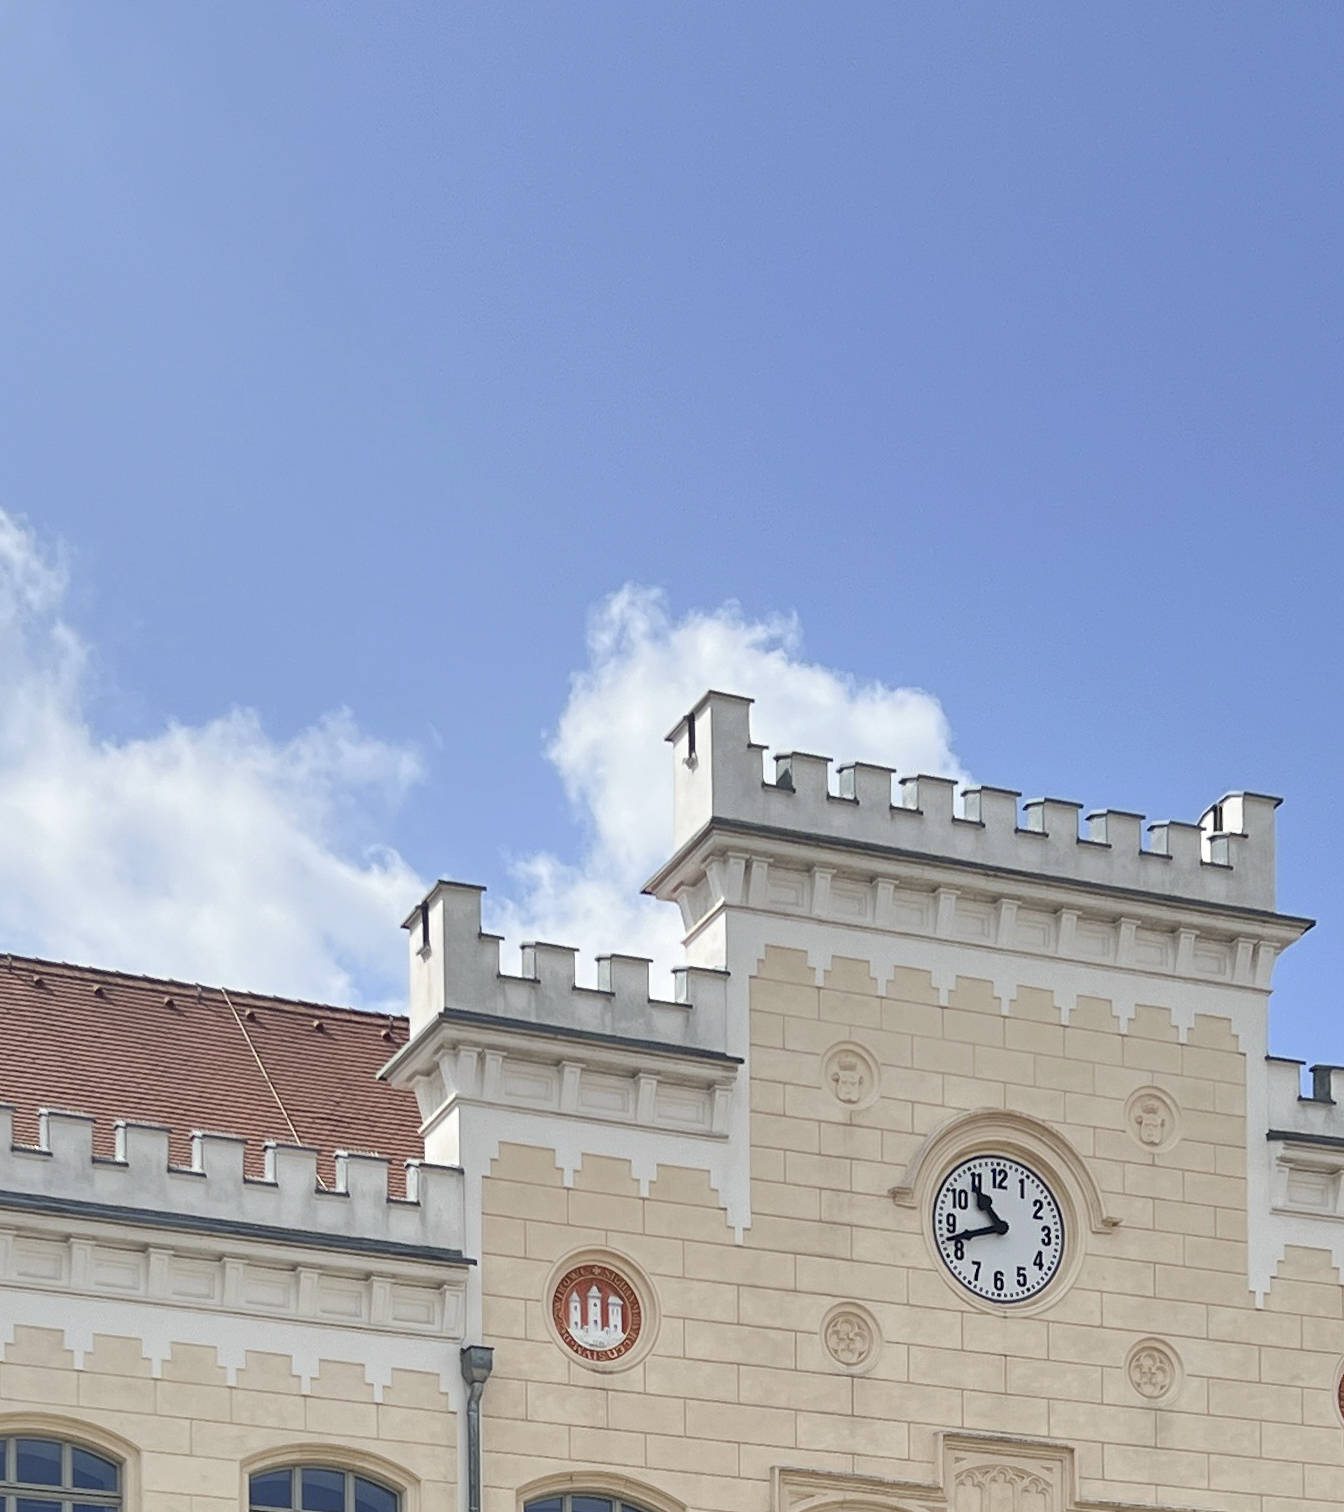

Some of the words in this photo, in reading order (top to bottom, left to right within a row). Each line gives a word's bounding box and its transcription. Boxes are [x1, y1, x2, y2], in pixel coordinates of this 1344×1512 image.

[970, 1172, 982, 1193] 11
[990, 1168, 1008, 1191] 12
[1018, 1178, 1025, 1199] 1
[950, 1188, 968, 1210] 10
[1032, 1199, 1044, 1220] 2
[946, 1212, 956, 1234] 9
[1041, 1225, 1052, 1247] 3
[954, 1239, 965, 1261] 8
[1033, 1250, 1044, 1271] 4
[971, 1260, 982, 1282] 7
[993, 1270, 1004, 1291] 6
[1016, 1266, 1028, 1288] 5
